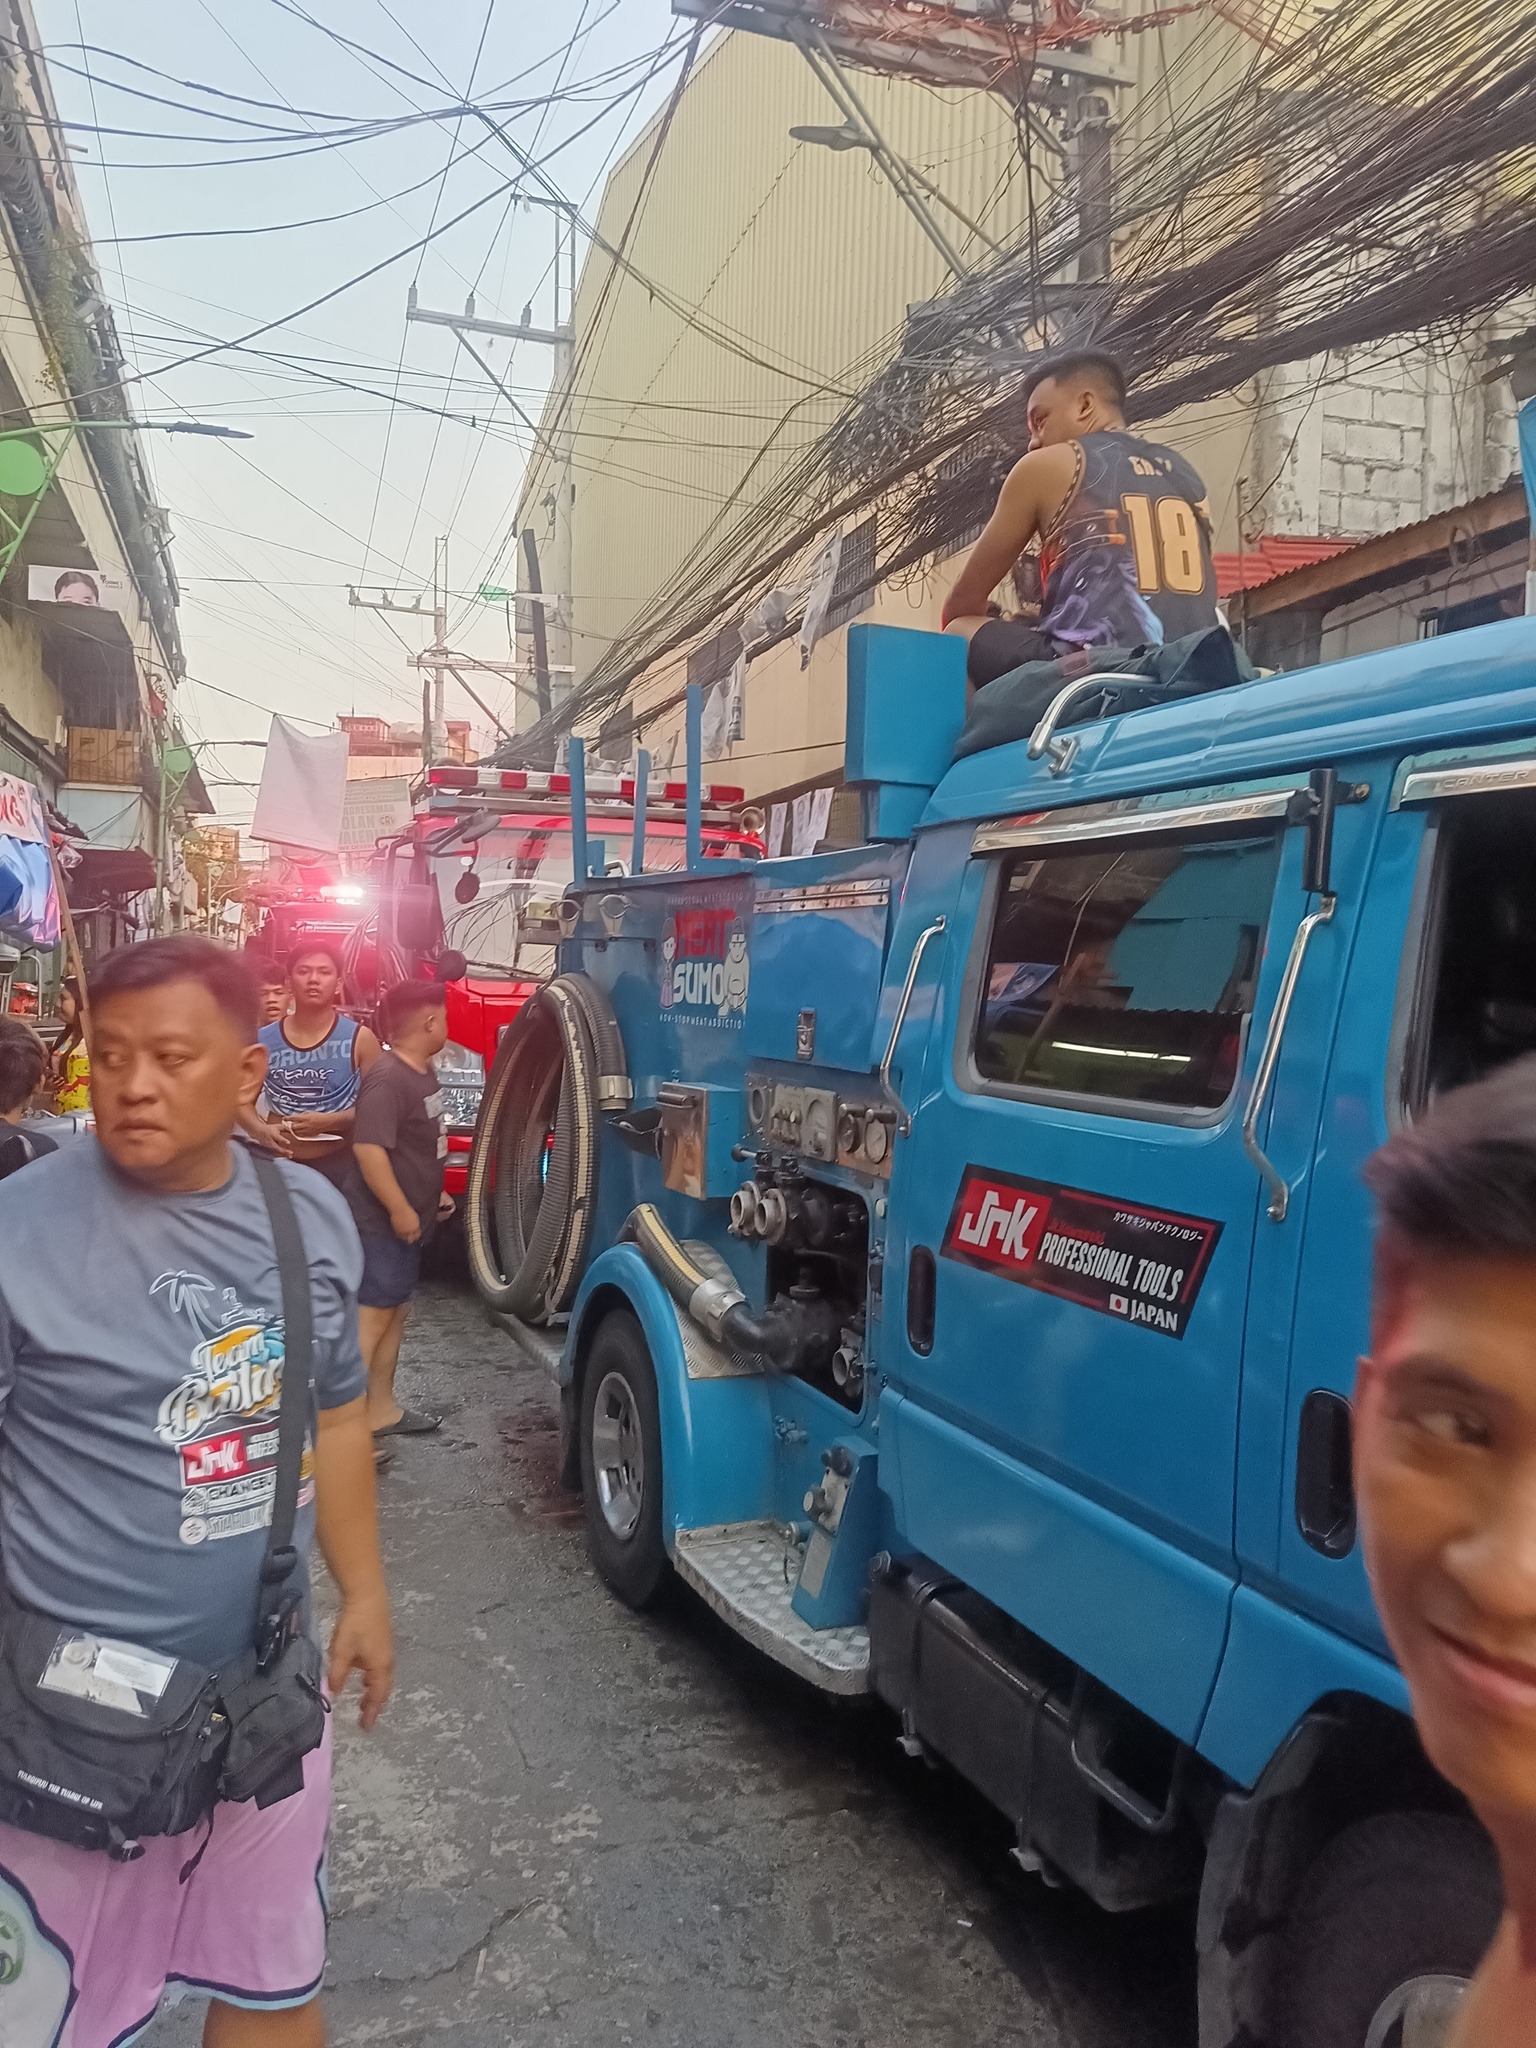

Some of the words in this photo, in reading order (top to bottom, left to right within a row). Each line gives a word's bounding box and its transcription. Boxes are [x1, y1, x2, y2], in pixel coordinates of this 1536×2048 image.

[1121, 493, 1204, 594] 18
[673, 961, 725, 1006] SUMO
[267, 1039, 352, 1069] ORONTO
[1038, 1232, 1134, 1287] PROFESSIONAL
[1132, 1258, 1184, 1302] TOOLS
[1129, 1299, 1178, 1332] JAPAN
